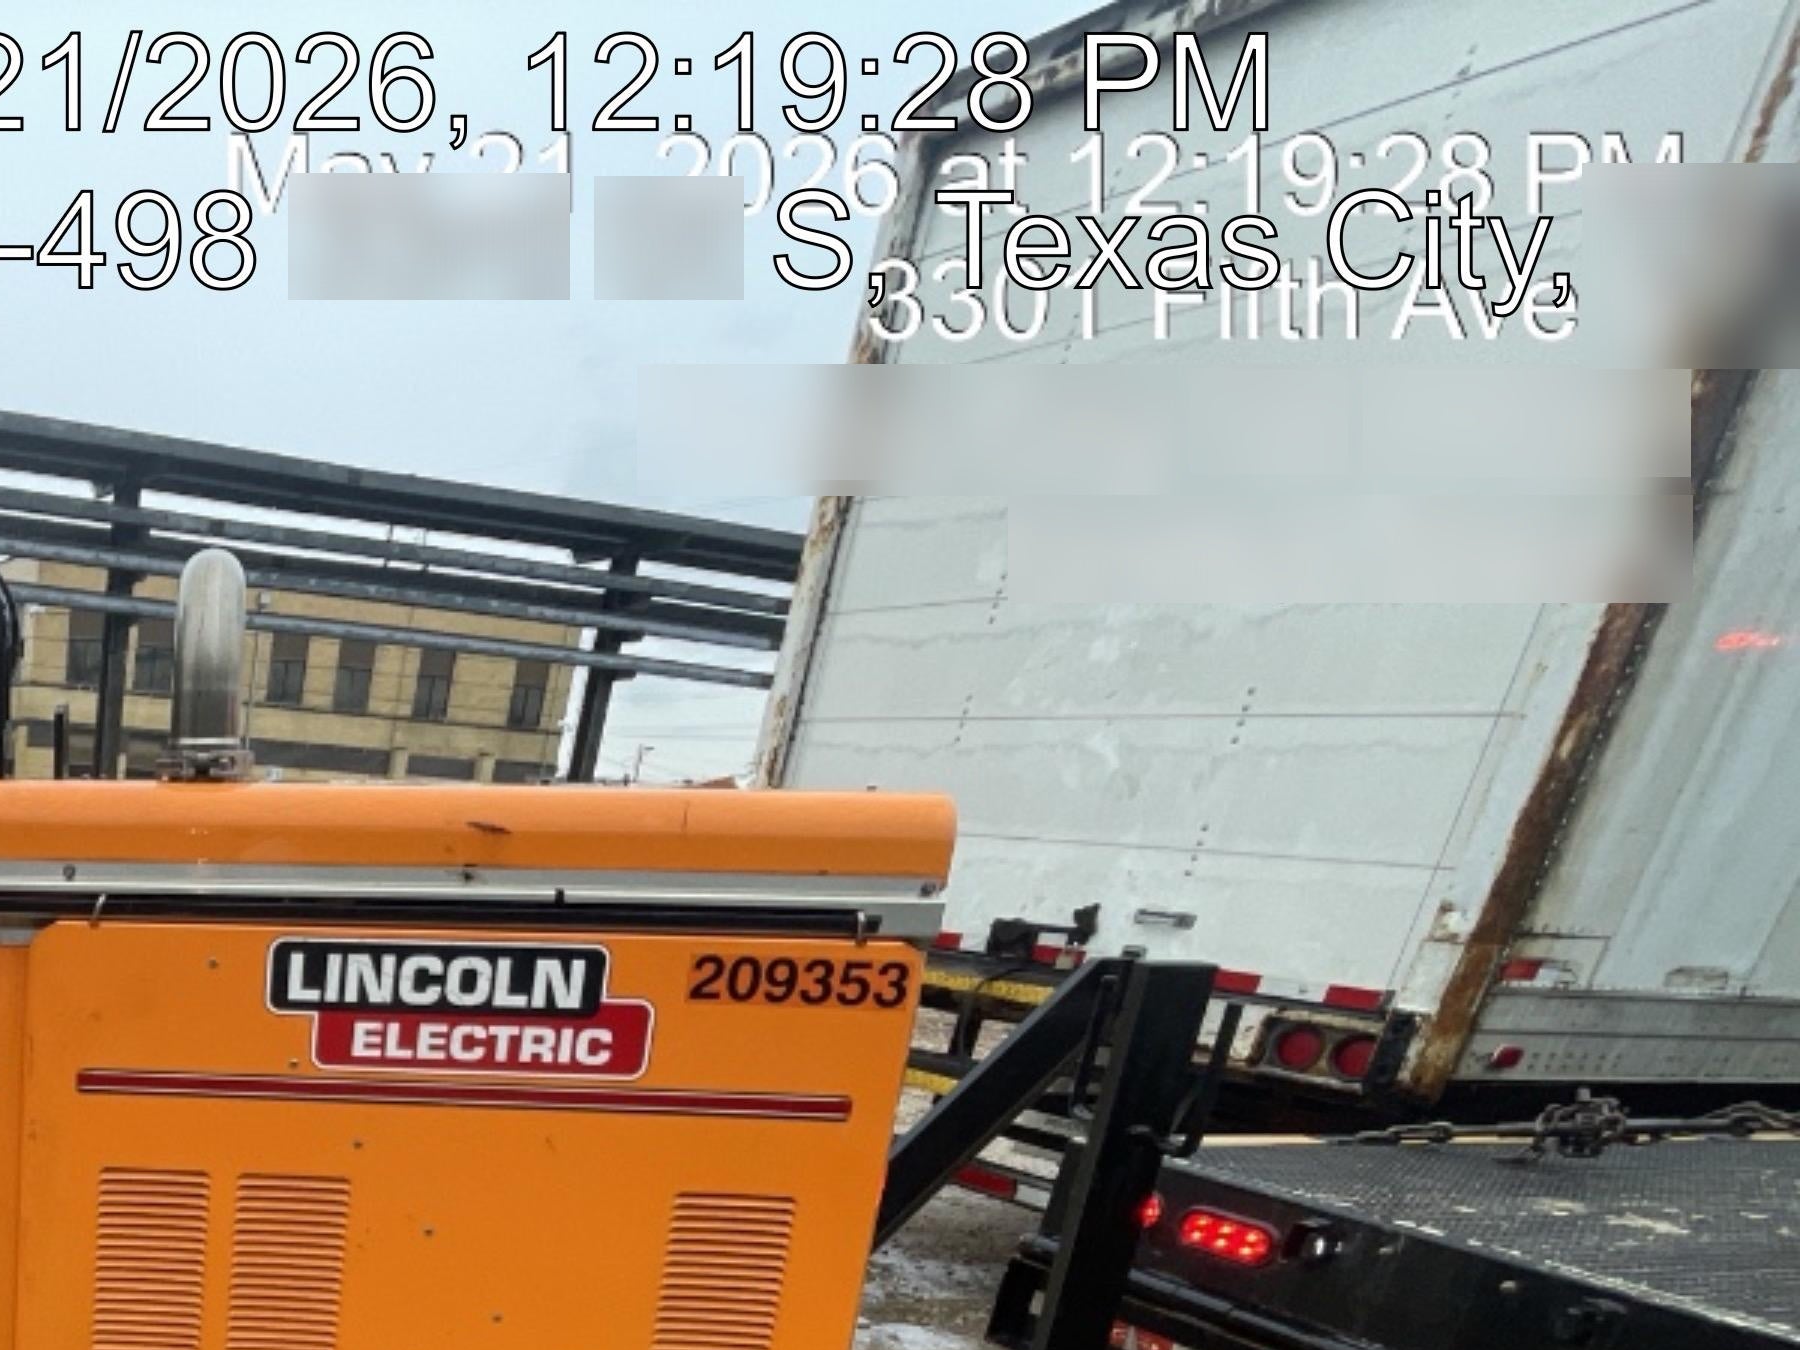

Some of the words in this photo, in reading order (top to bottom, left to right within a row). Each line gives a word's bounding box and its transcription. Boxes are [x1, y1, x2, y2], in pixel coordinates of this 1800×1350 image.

[287, 951, 586, 1009] LINCOLN
[688, 954, 910, 1008] 209353
[351, 1019, 614, 1065] ELECTRIC
